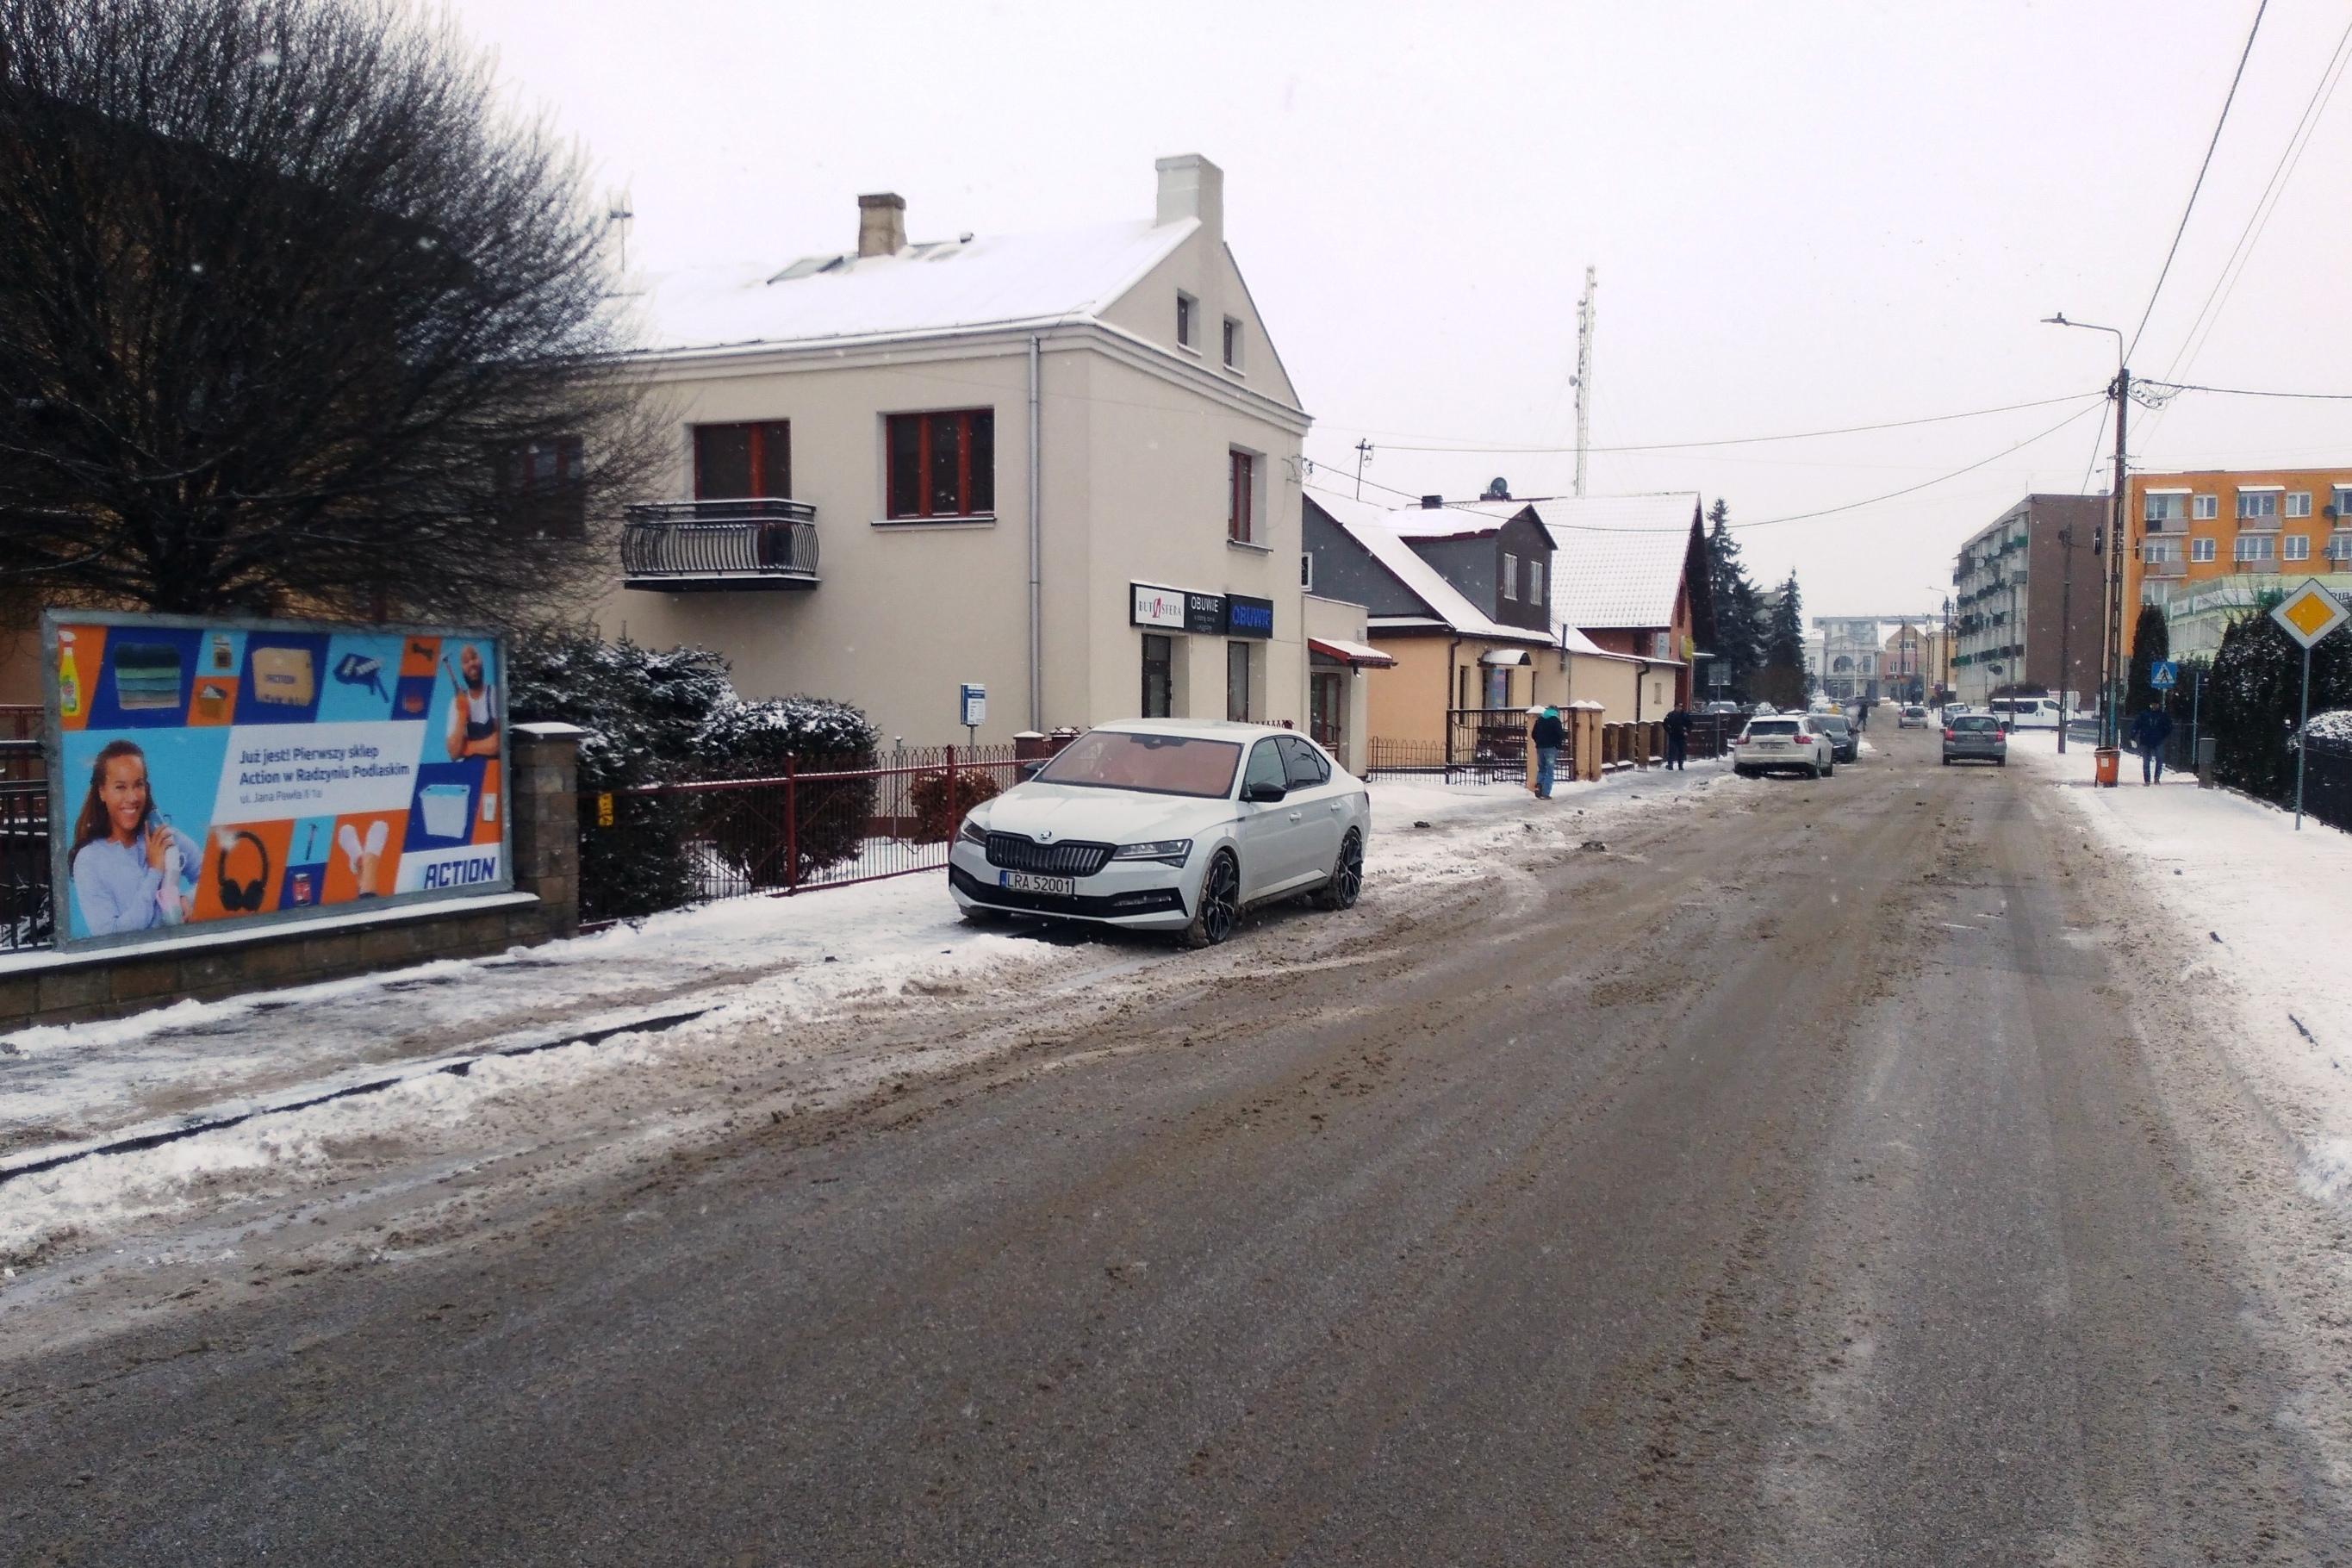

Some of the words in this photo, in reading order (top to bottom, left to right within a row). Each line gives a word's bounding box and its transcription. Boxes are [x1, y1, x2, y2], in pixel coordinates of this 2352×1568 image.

[1191, 595, 1219, 613] OBUWIE
[1232, 606, 1271, 628] OBUWIE
[240, 750, 261, 764] Już
[262, 748, 290, 766] jest!
[293, 747, 345, 762] Pierwszy
[348, 744, 379, 760] sklep
[240, 769, 280, 786] Action
[282, 772, 293, 782] w
[296, 766, 350, 783] Radzyniu
[352, 762, 410, 778] Podlaskim
[253, 791, 275, 803] Jana
[423, 856, 496, 890] ACTION
[1007, 874, 1030, 889] LRA
[1033, 876, 1070, 893] 52001
